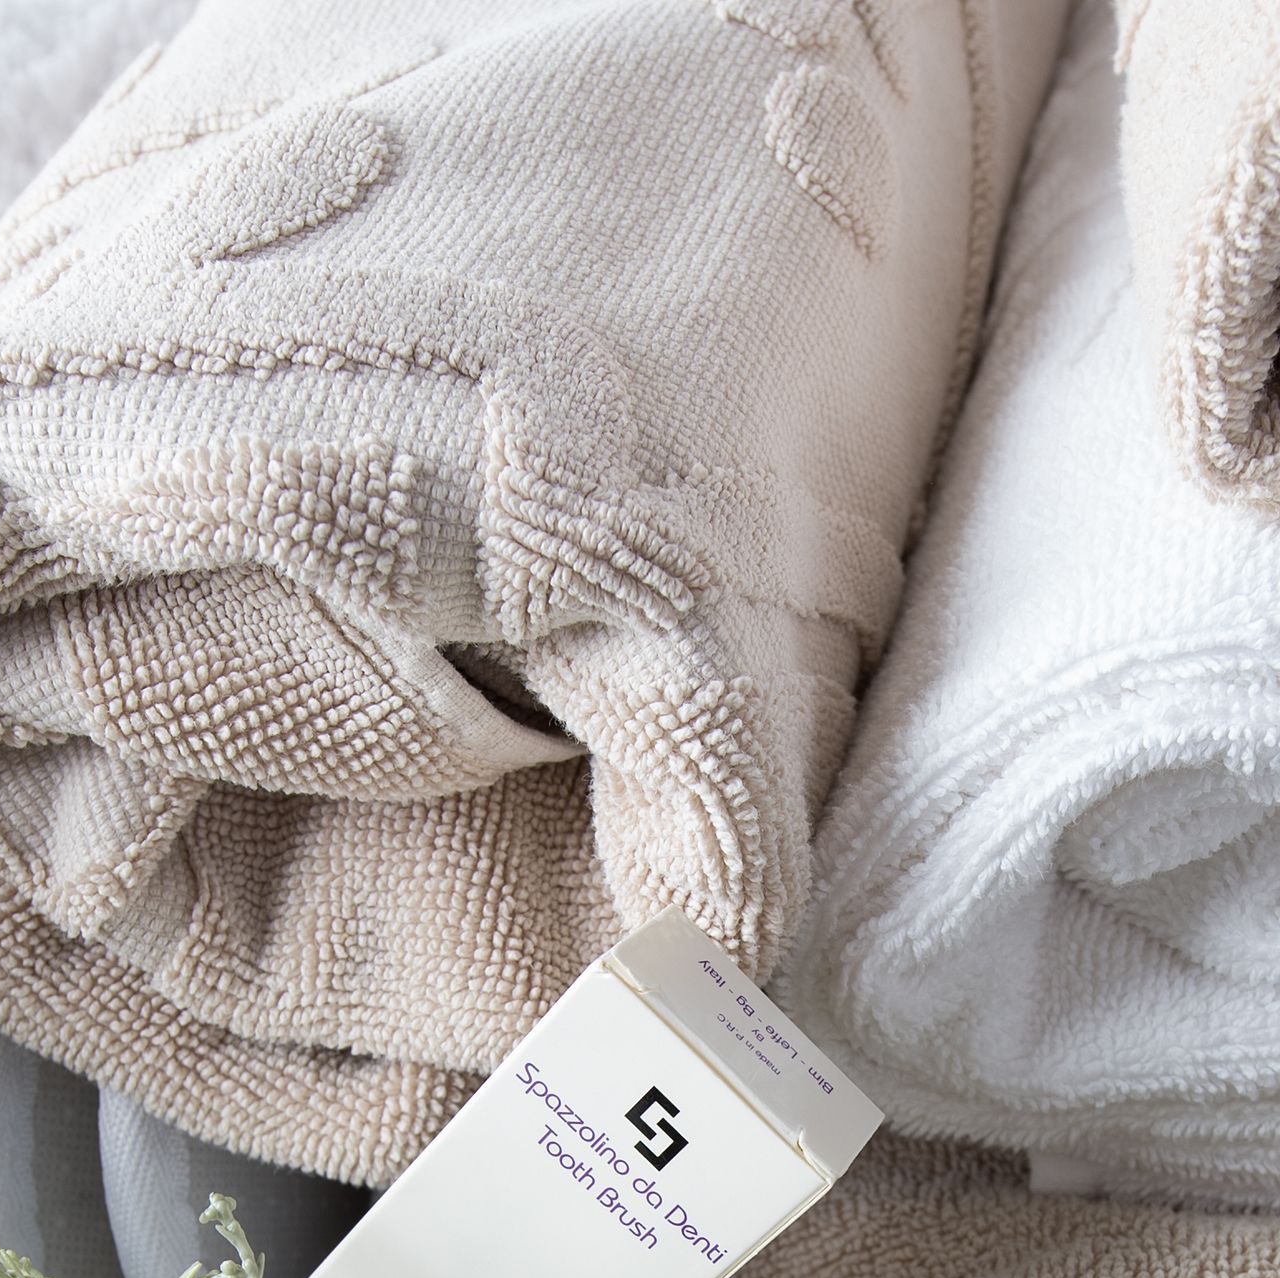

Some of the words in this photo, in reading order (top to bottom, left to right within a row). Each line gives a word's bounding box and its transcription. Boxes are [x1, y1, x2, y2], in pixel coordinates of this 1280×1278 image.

[698, 959, 726, 988] Italy
[736, 995, 755, 1017] Bg
[745, 1040, 757, 1051] in
[751, 1028, 765, 1043] By
[765, 1025, 799, 1059] Leffe
[754, 1050, 781, 1075] made
[516, 1062, 630, 1176] Spazzolino
[632, 1178, 663, 1210] da
[664, 1204, 728, 1264] Denti
[537, 1124, 596, 1191] Tooth
[596, 1187, 658, 1250] Brush
